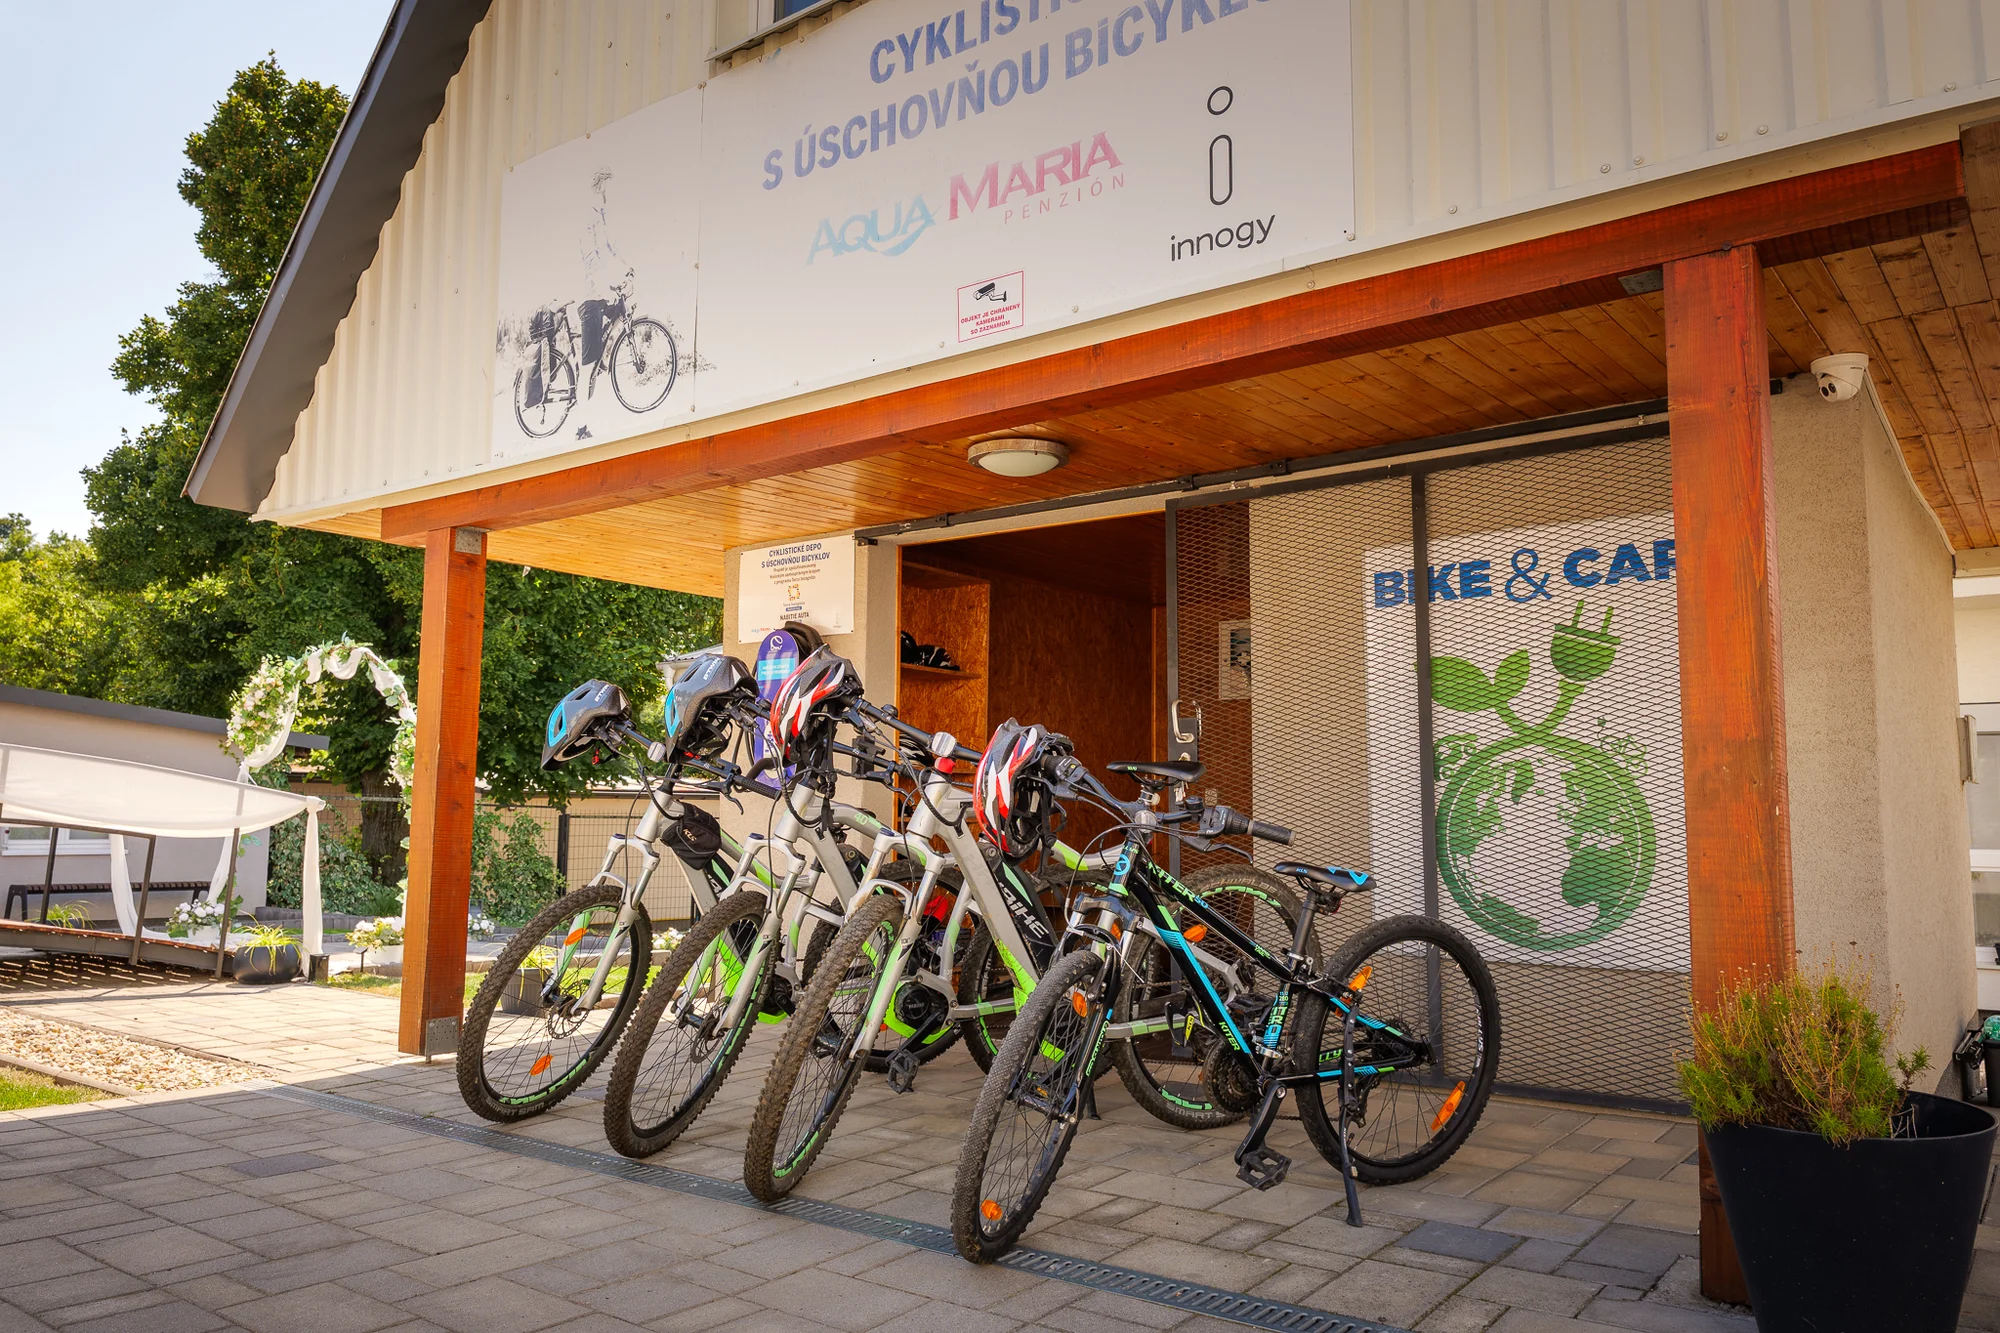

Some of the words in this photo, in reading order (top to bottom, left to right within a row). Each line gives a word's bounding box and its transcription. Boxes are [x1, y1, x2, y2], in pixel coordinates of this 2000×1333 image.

[762, 149, 784, 190] S
[794, 43, 1049, 178] ÚSCHOVŇOU
[804, 193, 937, 266] AQUA
[948, 131, 1124, 222] MARIA
[1004, 173, 1125, 225] PENZIÓN
[1170, 214, 1276, 262] innogy
[960, 313, 981, 324] OBJEKT
[975, 314, 1005, 326] KAMERAMI
[801, 551, 831, 562] BICYKLOV
[805, 542, 822, 552] DEPO
[1504, 548, 1551, 603] &
[683, 829, 697, 842] KLS
[1218, 1021, 1241, 1051] KITER
[1166, 1102, 1213, 1120] SMART
